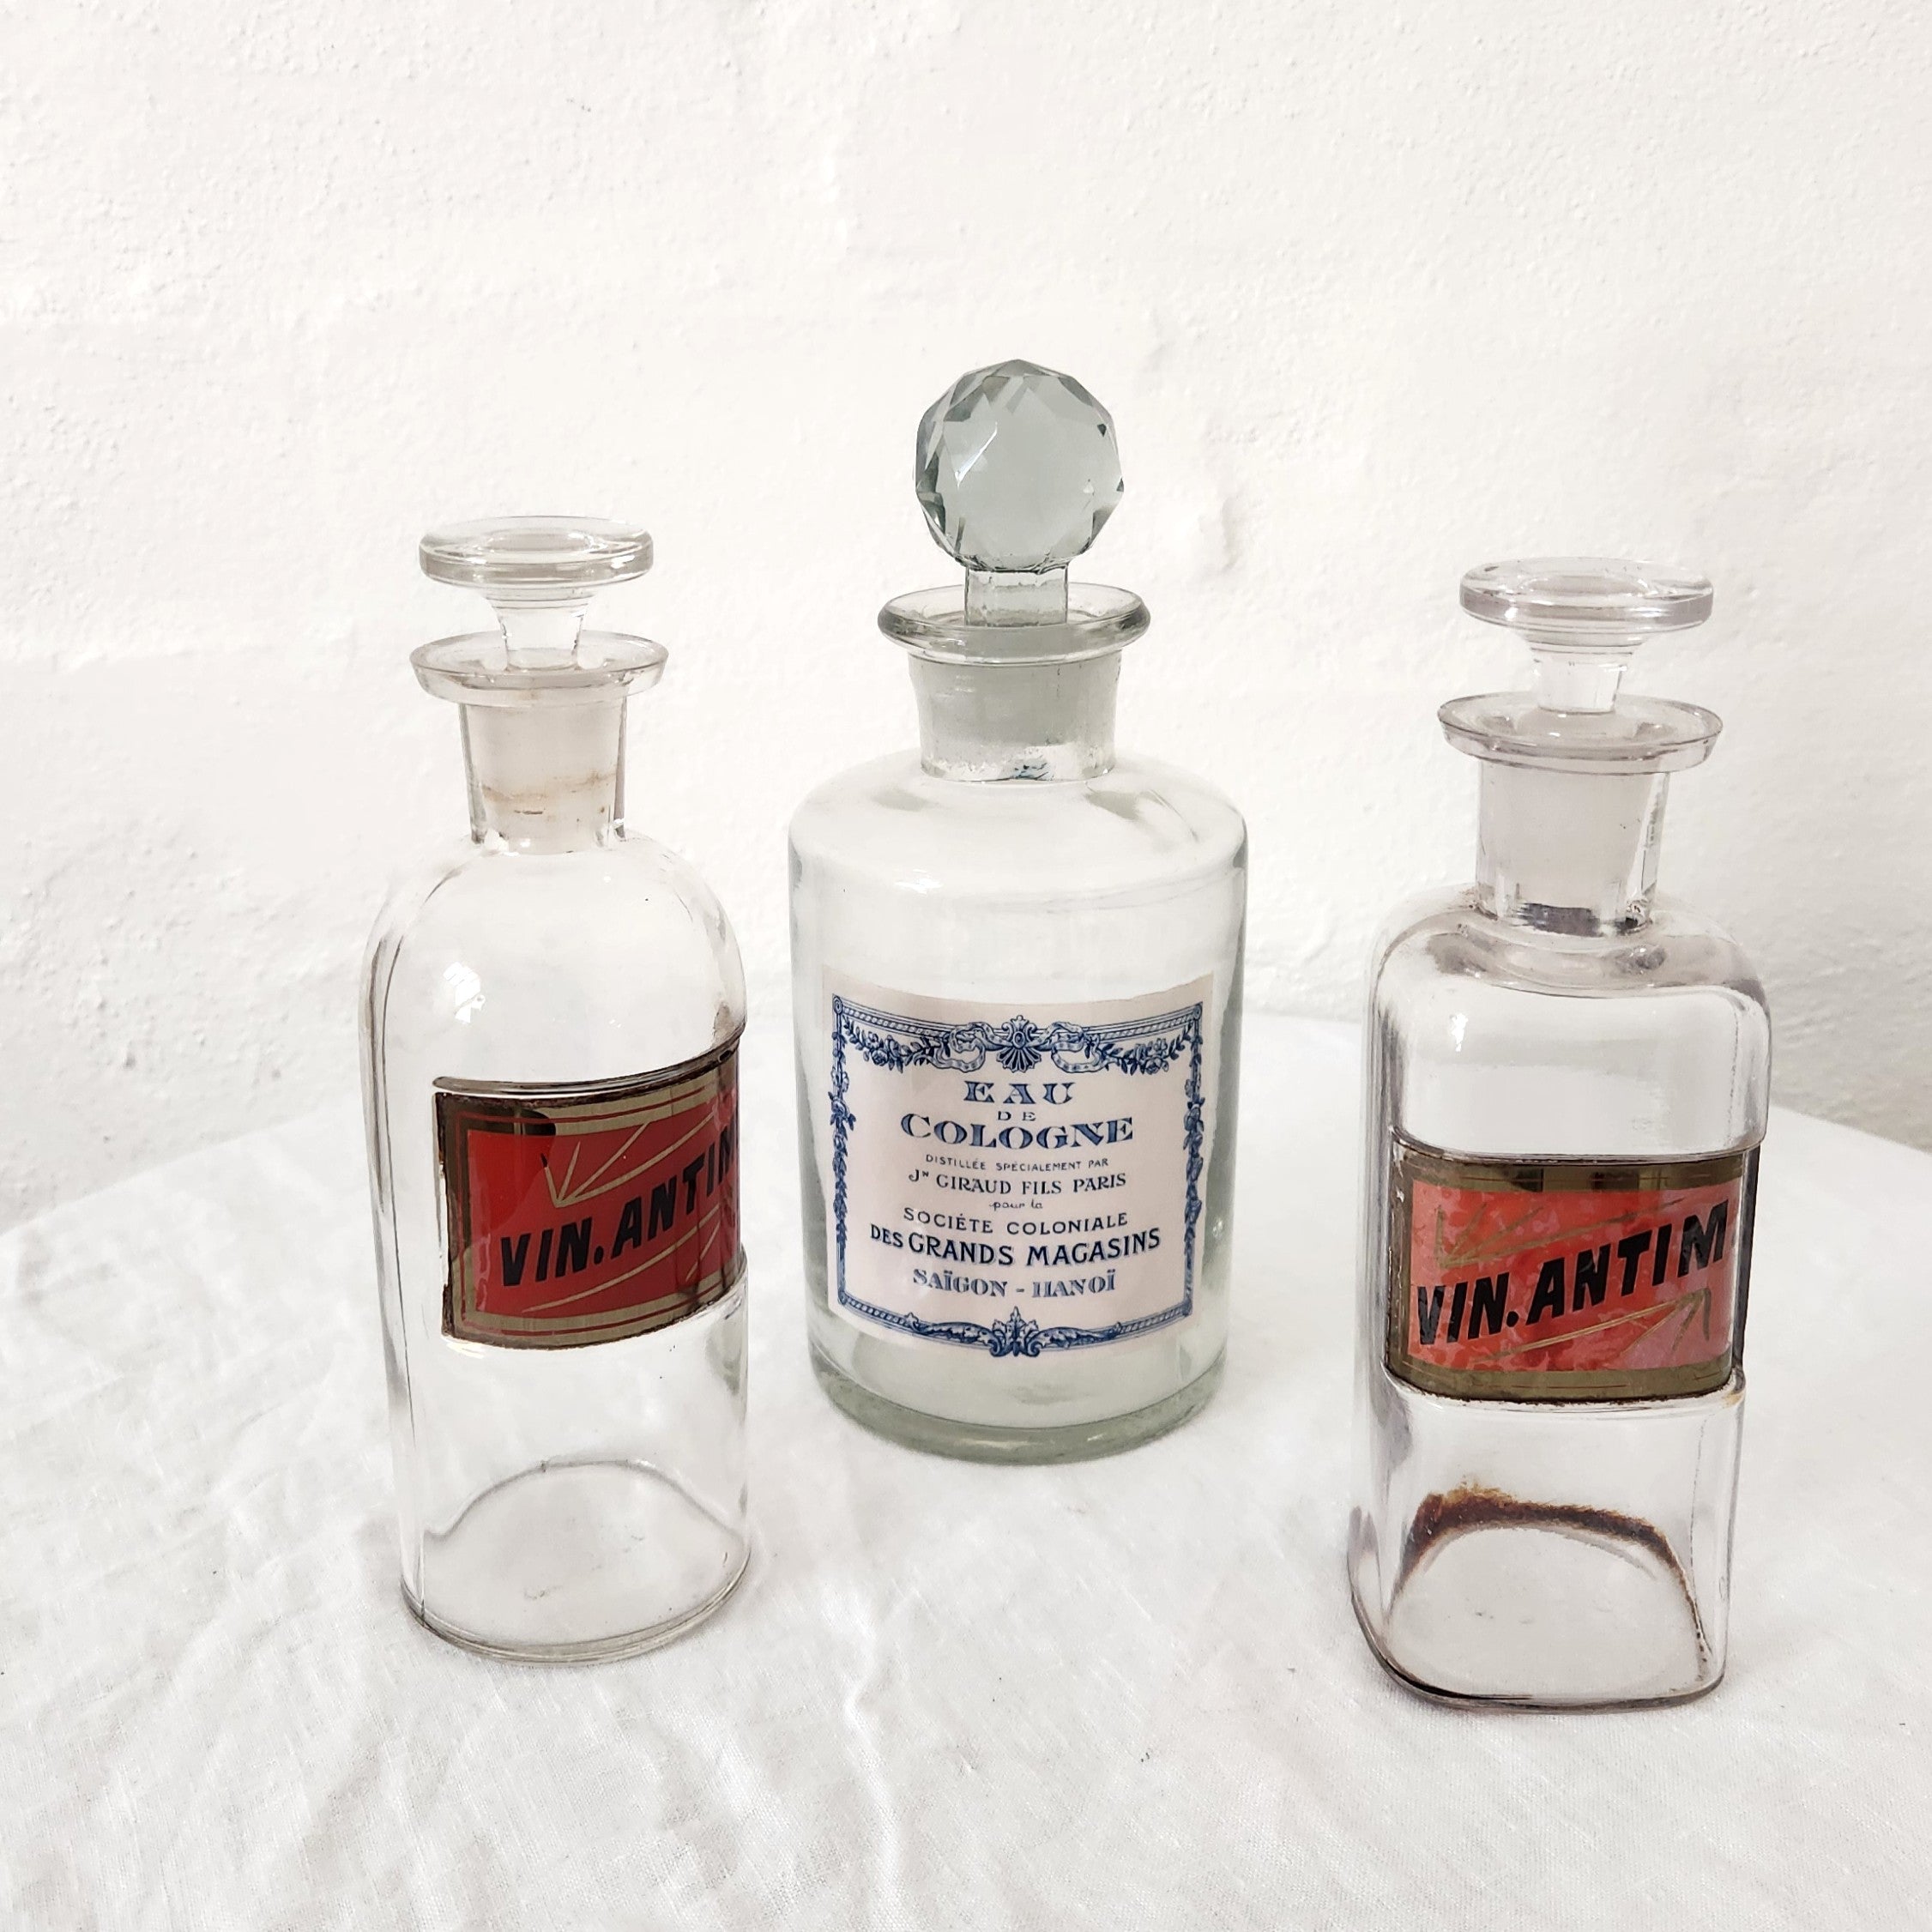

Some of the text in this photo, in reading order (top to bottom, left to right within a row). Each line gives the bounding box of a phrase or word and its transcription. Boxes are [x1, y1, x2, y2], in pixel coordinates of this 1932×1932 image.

[963, 1080, 1076, 1105] EAU
[997, 1111, 1036, 1122] DE
[901, 1114, 1132, 1150] COLOGNE
[926, 1154, 1109, 1172] DISTILLÉE SPÉCIALEMENT PAR
[936, 1174, 1011, 1195] GIRAUD
[1022, 1180, 1062, 1195] FILS
[1072, 1173, 1127, 1193] PARIS
[989, 1198, 1043, 1211] pour la
[1006, 1212, 1128, 1235] COLONIALE
[870, 1223, 1161, 1266] DES GRANDS MAGASINS
[913, 1268, 1008, 1298] SAÏGON
[1032, 1268, 1116, 1298] HANOÏ
[1416, 1199, 1730, 1345] VIN.ANTIM
